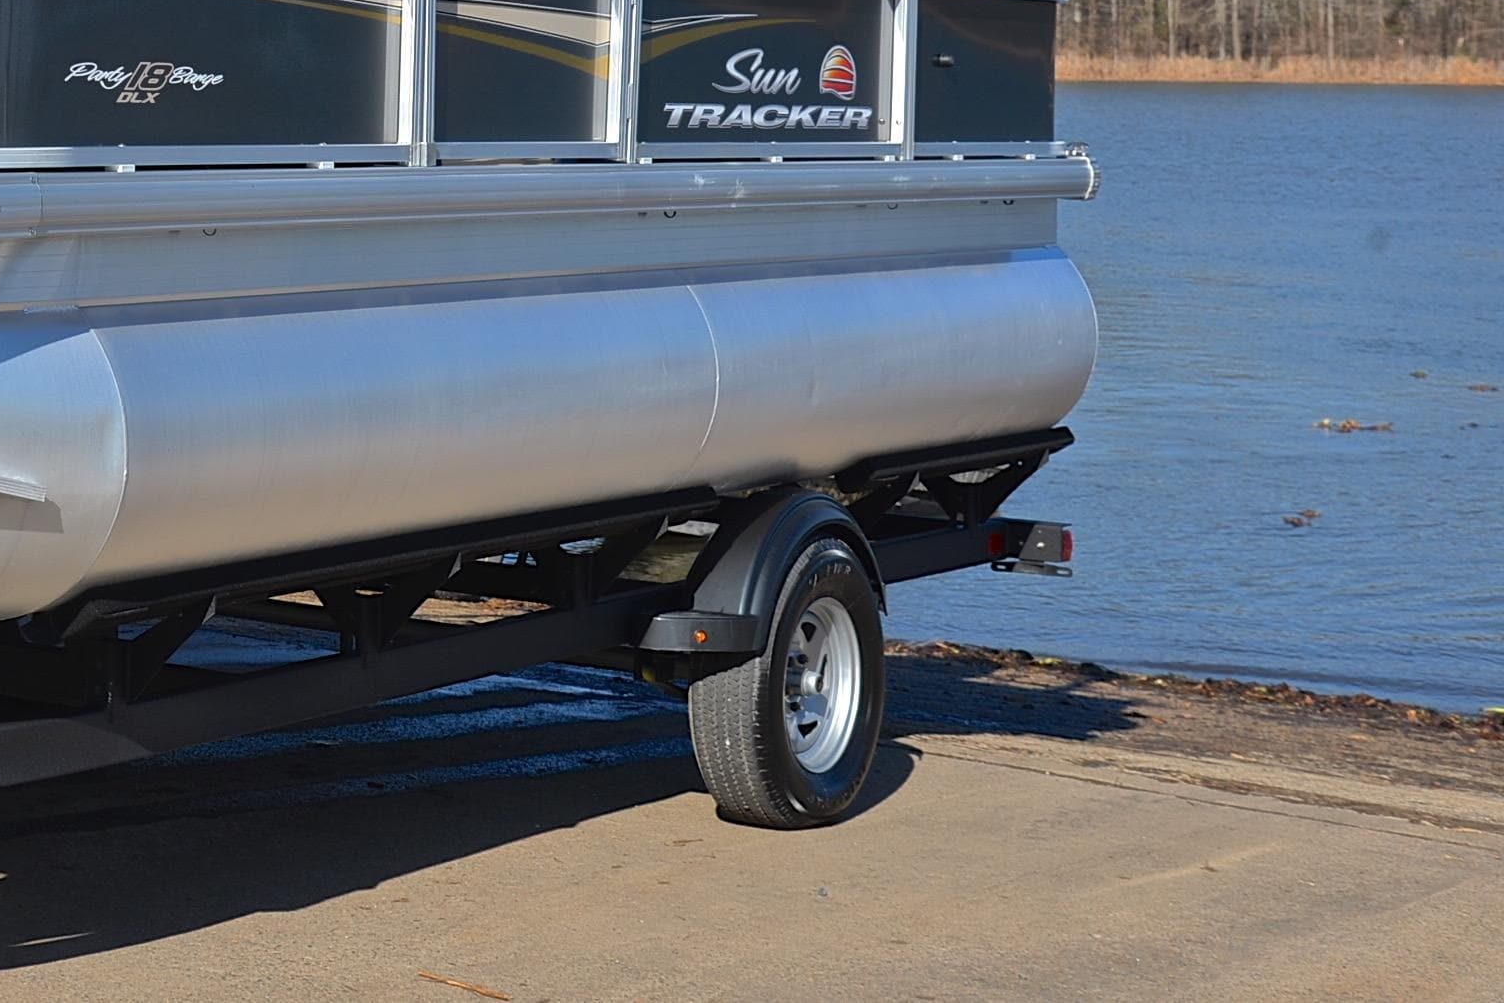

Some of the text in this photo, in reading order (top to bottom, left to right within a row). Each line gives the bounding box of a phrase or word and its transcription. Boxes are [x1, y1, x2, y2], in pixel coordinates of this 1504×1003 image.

[64, 61, 225, 92] Party 18 Barge
[711, 48, 802, 95] Sun
[115, 91, 161, 104] DLX
[663, 102, 873, 130] TRACKER
